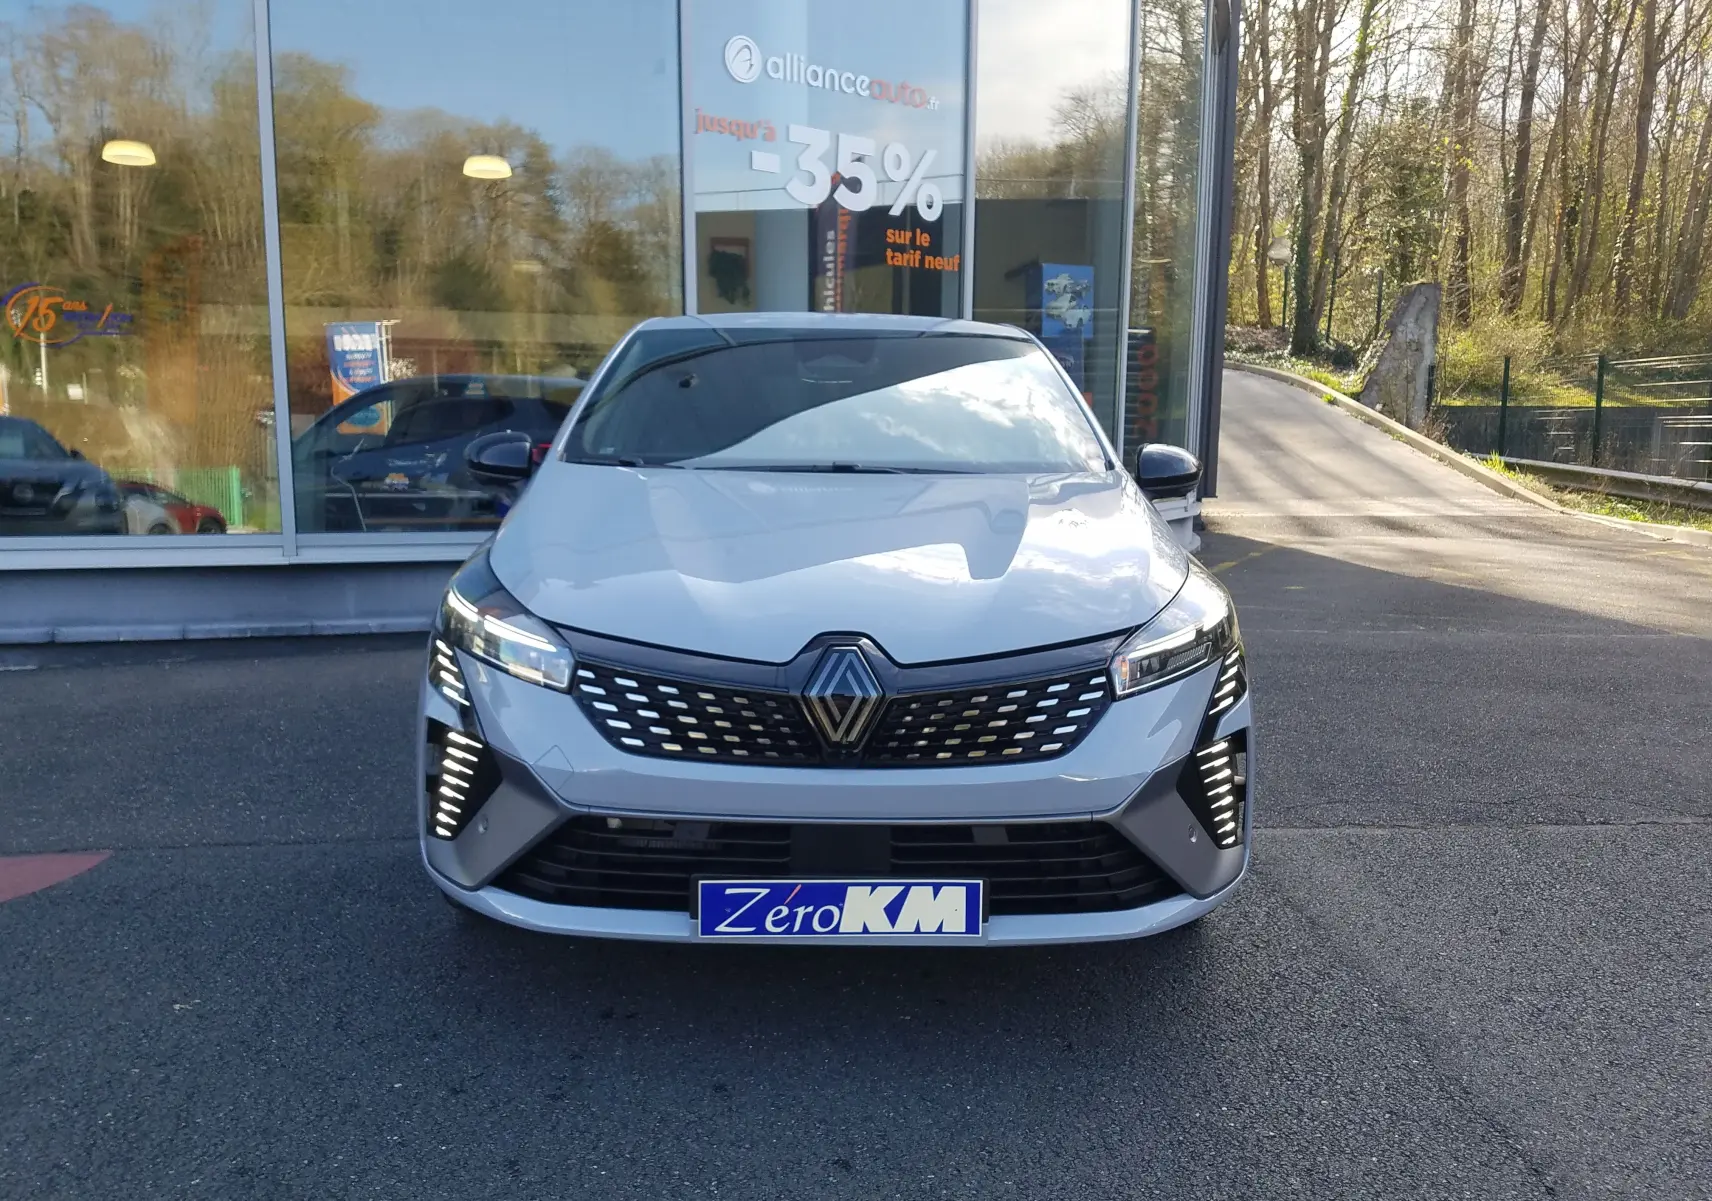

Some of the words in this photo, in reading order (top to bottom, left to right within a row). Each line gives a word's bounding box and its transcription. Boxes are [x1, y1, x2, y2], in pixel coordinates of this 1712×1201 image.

[696, 107, 777, 142] jusqu'à
[751, 124, 943, 221] -35%
[886, 228, 912, 245] sur
[915, 228, 930, 247] le
[823, 230, 835, 311] hicules
[886, 248, 921, 268] tarif
[925, 254, 960, 272] neuf
